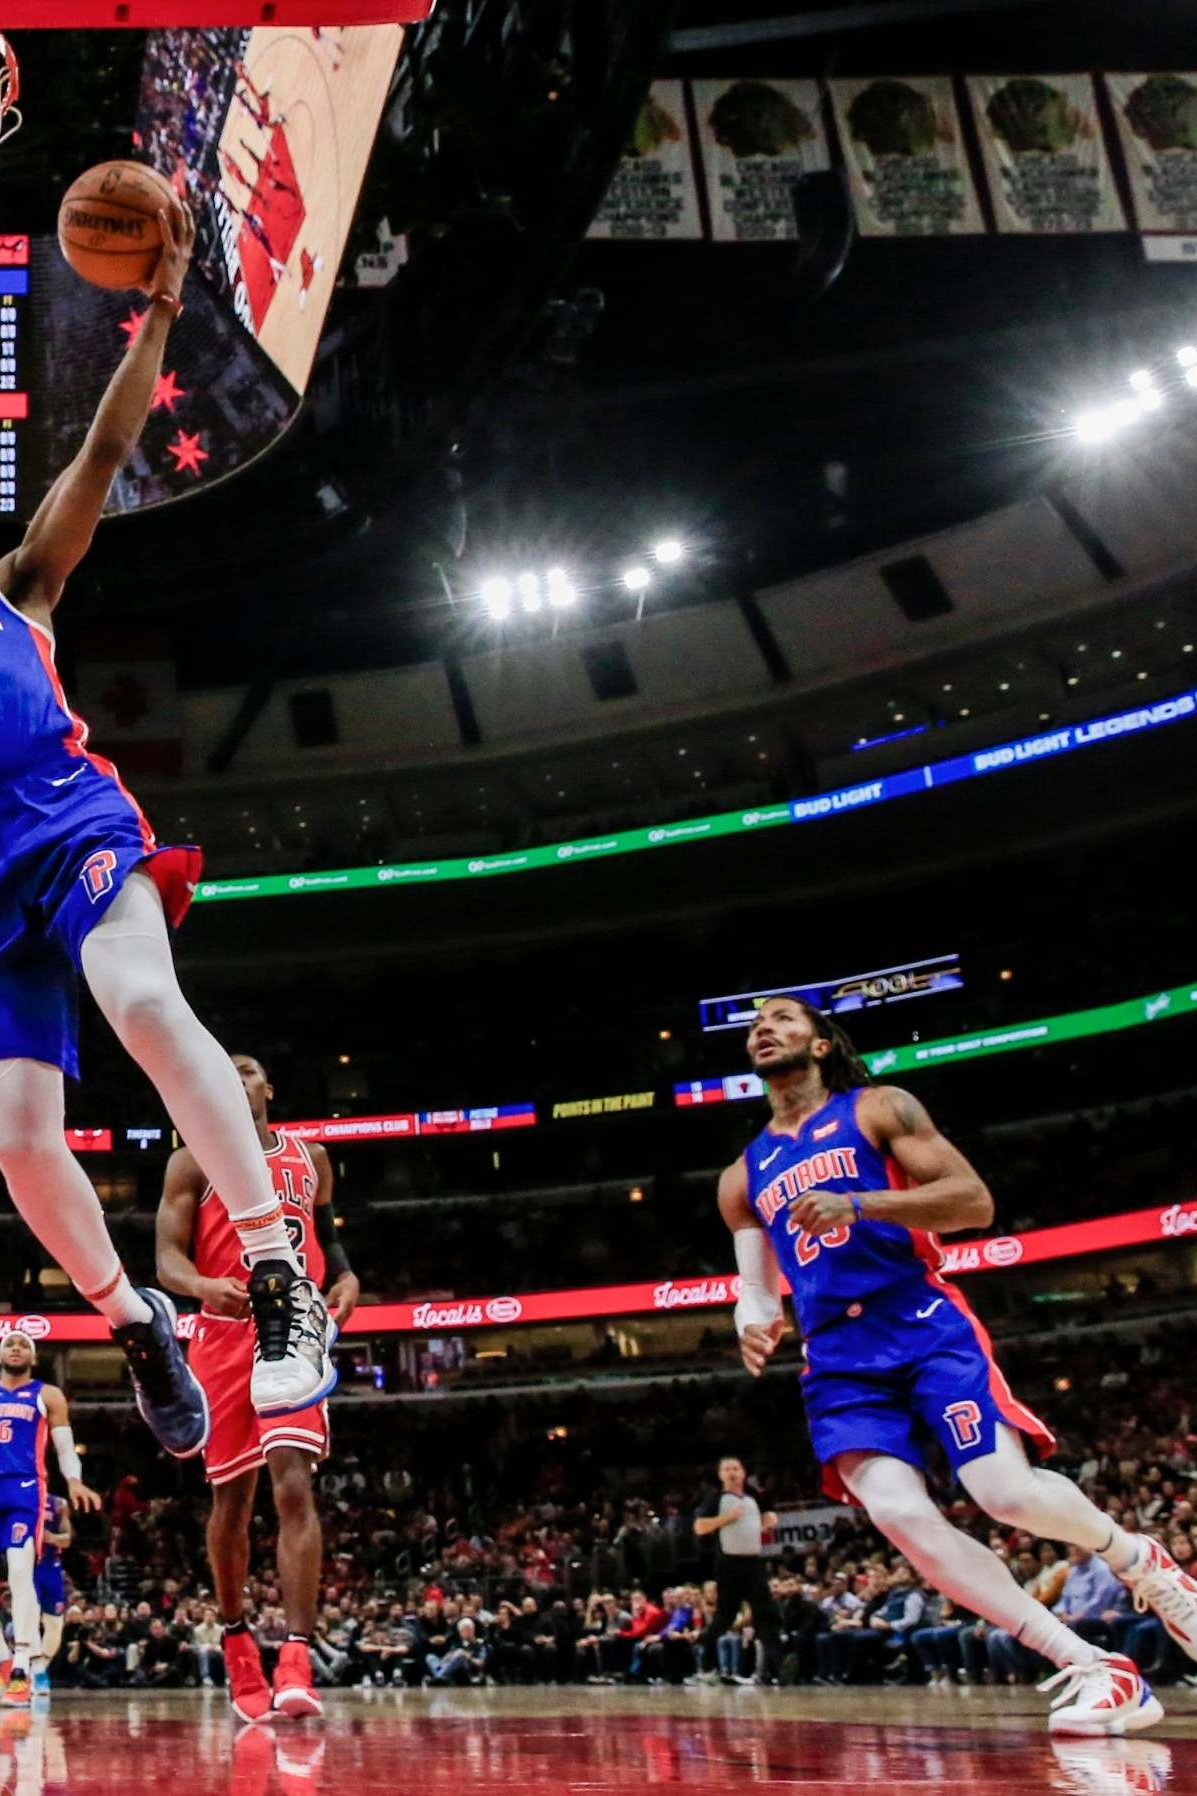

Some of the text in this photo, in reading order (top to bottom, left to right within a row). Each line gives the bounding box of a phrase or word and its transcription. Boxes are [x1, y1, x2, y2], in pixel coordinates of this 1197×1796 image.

[974, 747, 1015, 771] BUD
[1015, 731, 1070, 760] LIGHT
[794, 783, 883, 818] BUD LIGHT
[756, 1147, 858, 1226] DETROIT
